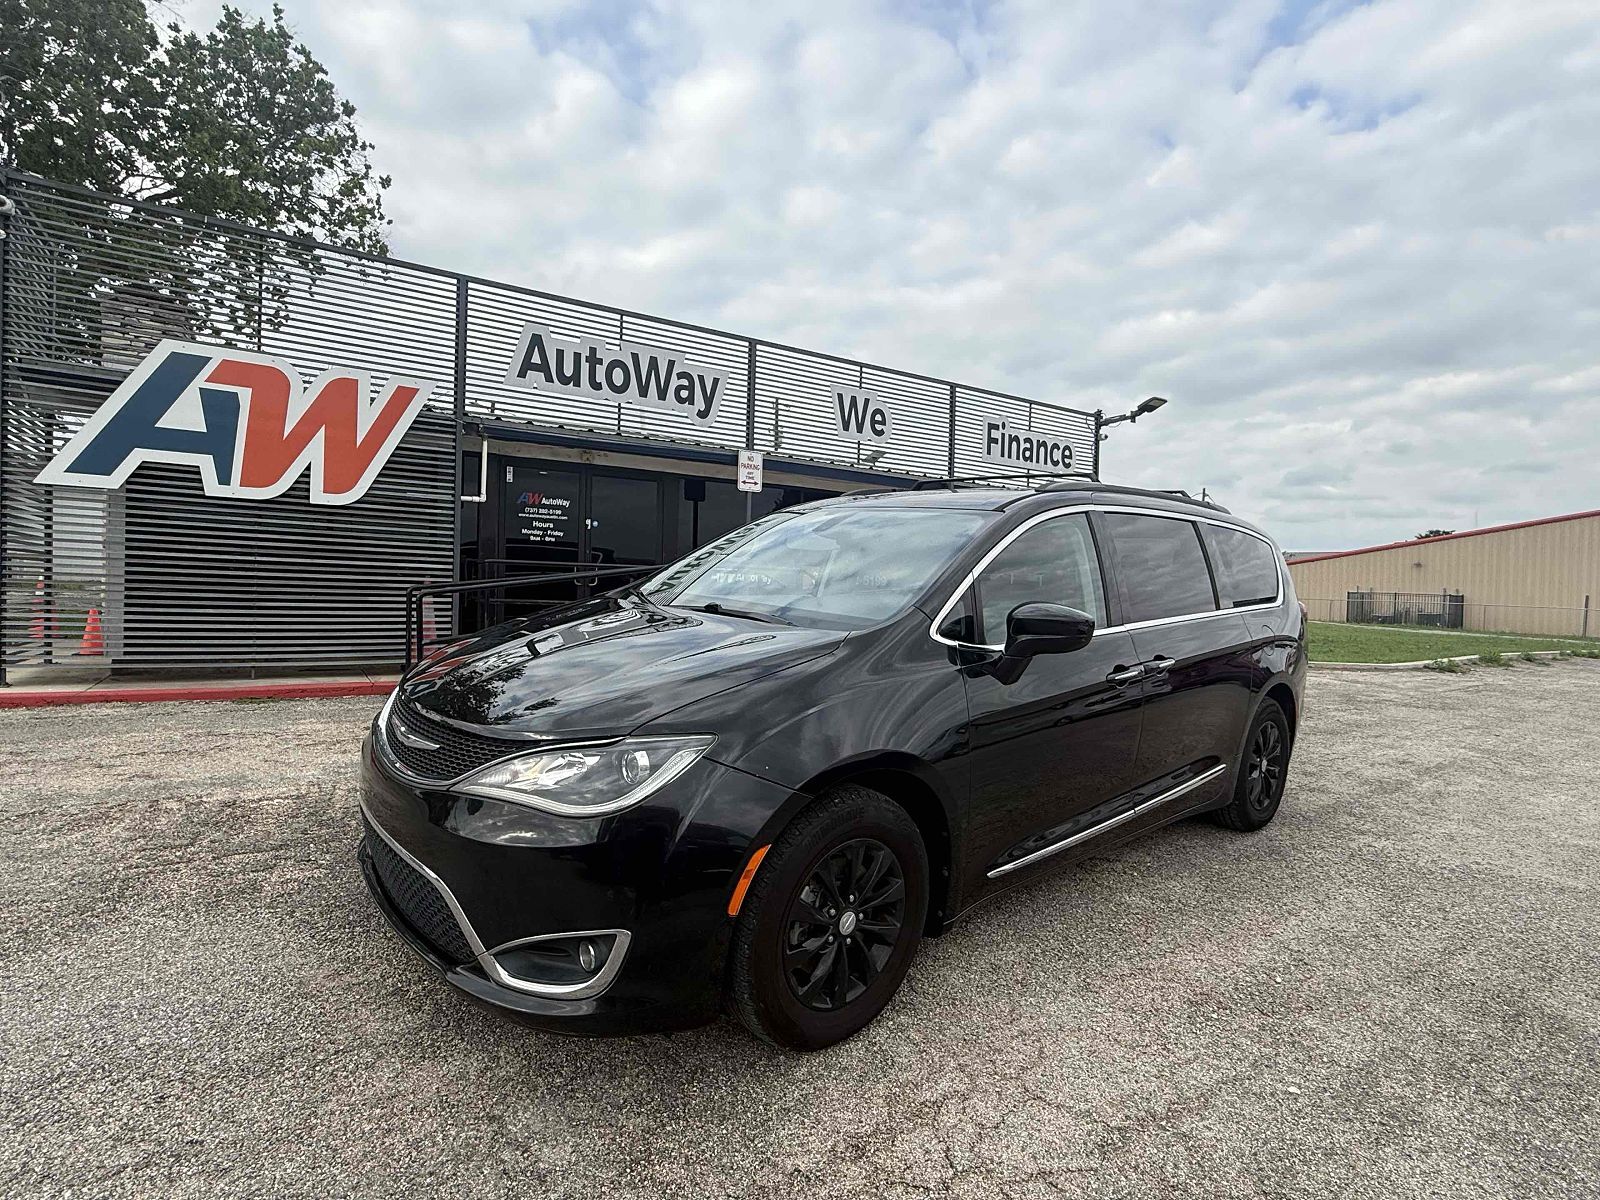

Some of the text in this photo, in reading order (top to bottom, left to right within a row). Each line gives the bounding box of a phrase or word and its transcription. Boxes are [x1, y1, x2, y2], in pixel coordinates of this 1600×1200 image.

[516, 332, 1074, 470] AutoWay We Finance
[63, 350, 421, 496] AW
[740, 462, 760, 470] PARKING
[541, 497, 570, 508] AutoWay
[532, 520, 554, 528] Hours
